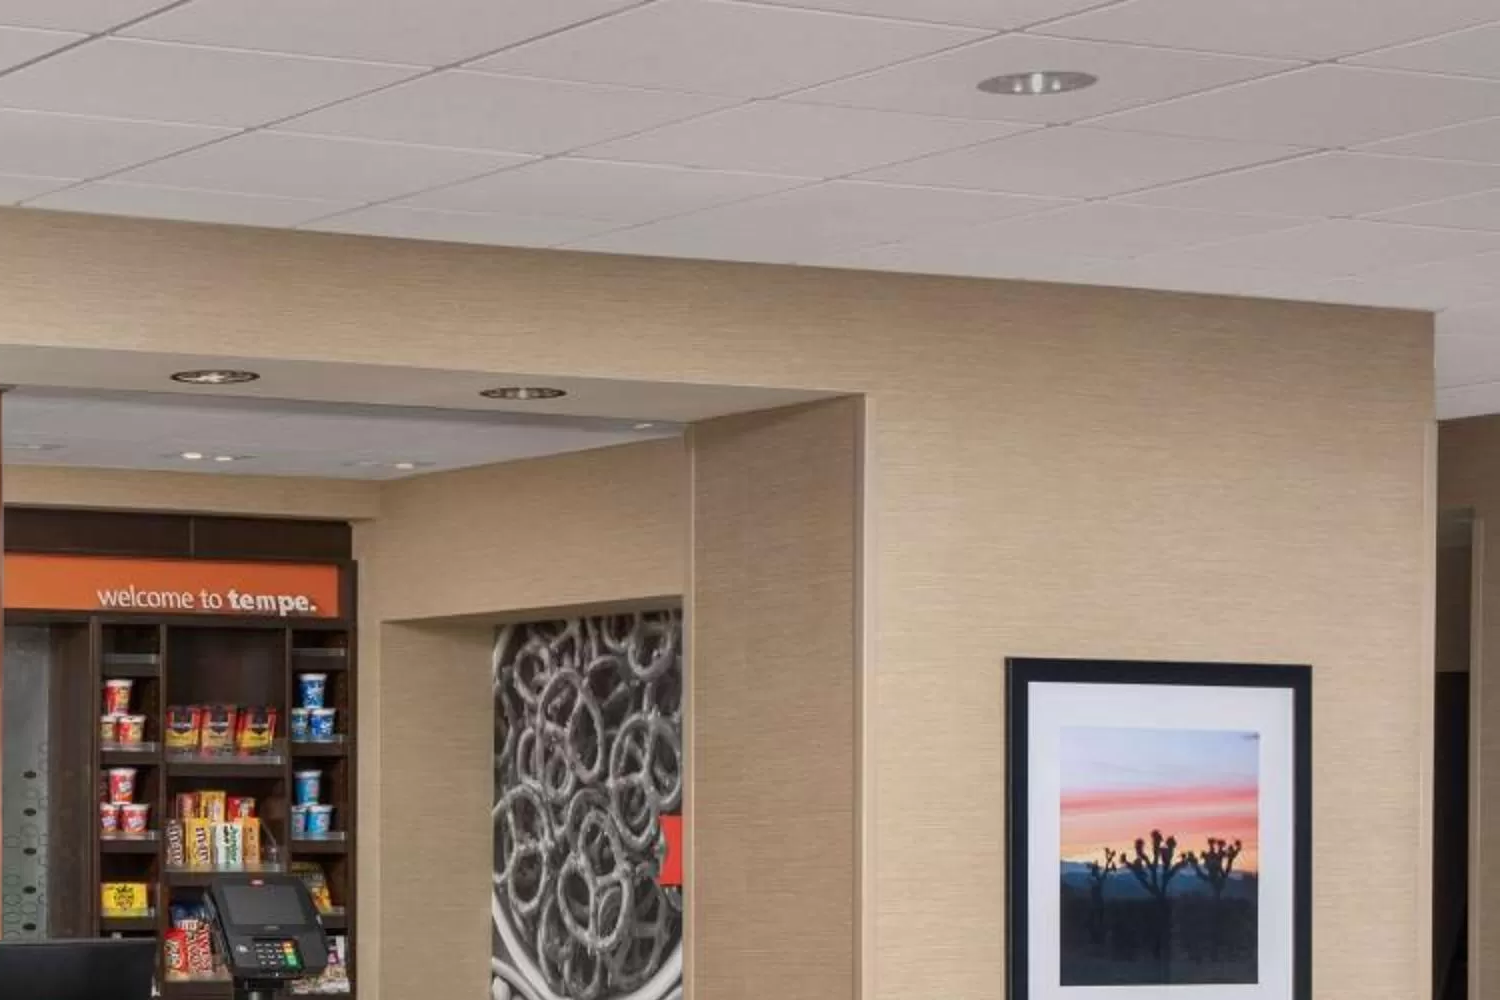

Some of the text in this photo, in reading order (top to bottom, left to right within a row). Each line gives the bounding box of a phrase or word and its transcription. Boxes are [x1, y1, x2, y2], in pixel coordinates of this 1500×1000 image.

[97, 584, 317, 616] welcome to tempe.
